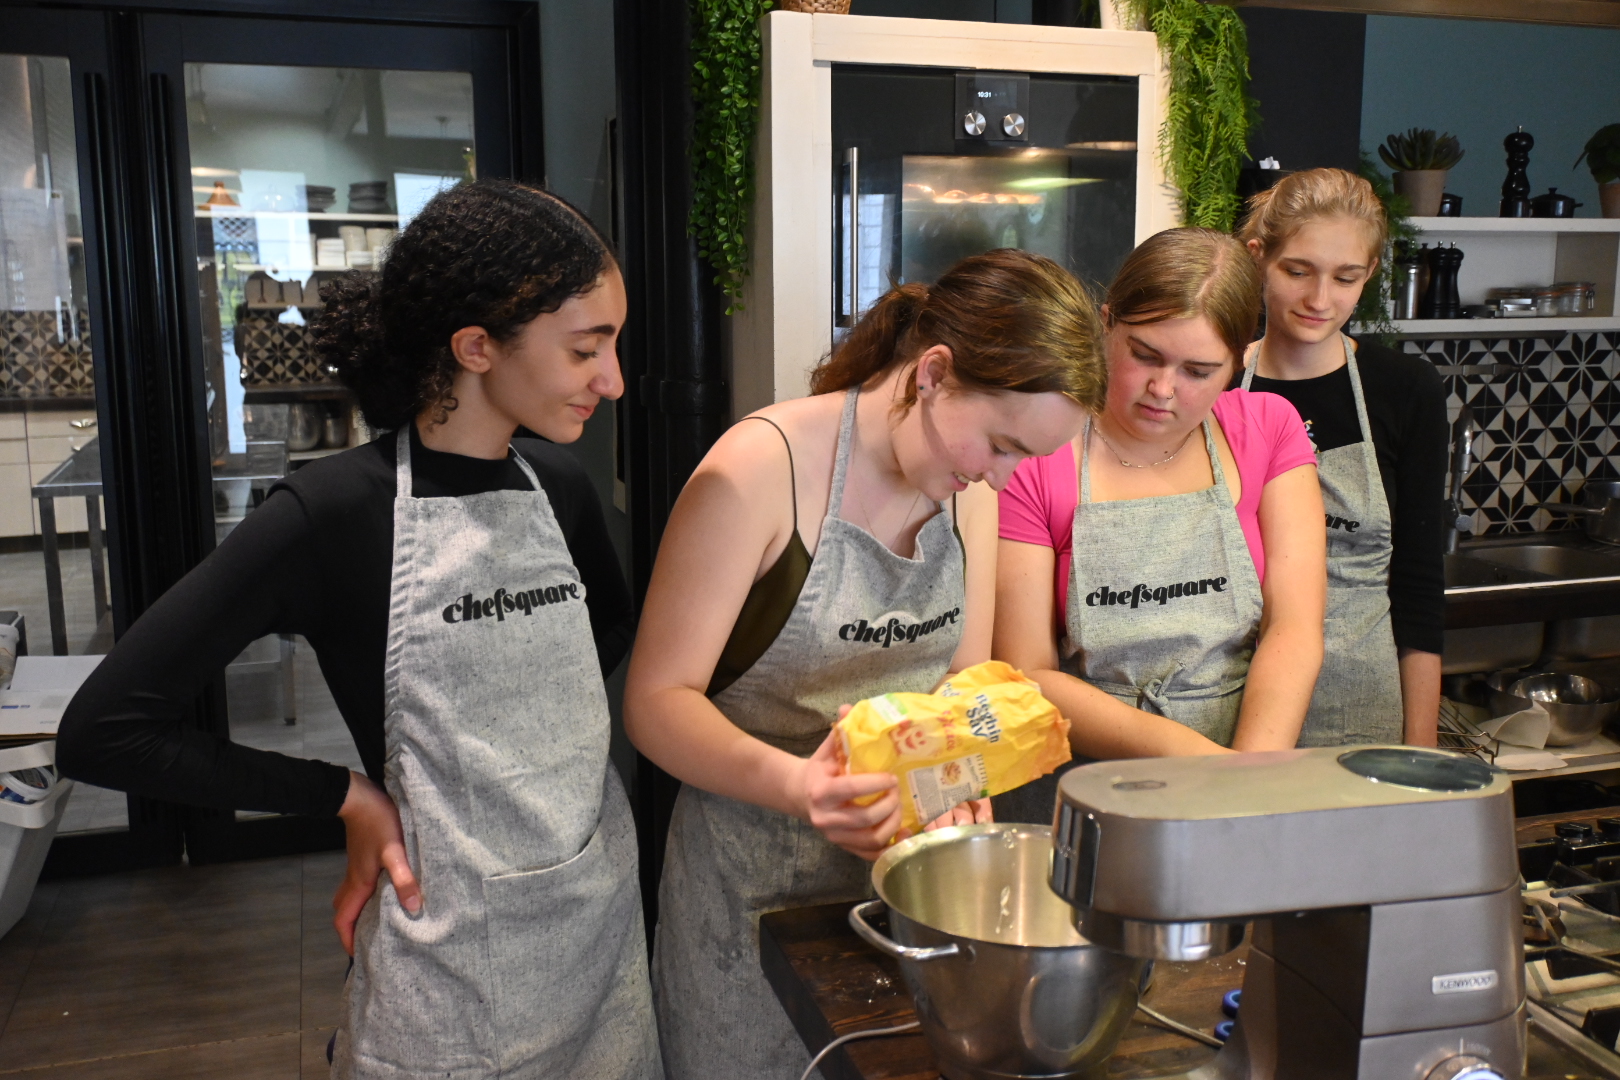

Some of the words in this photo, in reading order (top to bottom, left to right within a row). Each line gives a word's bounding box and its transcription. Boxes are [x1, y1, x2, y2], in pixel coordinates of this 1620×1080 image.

[442, 582, 581, 624] chefsquare
[1085, 576, 1228, 609] chefsquare
[838, 607, 960, 648] chefsquare
[1440, 976, 1491, 989] KENWOOD
